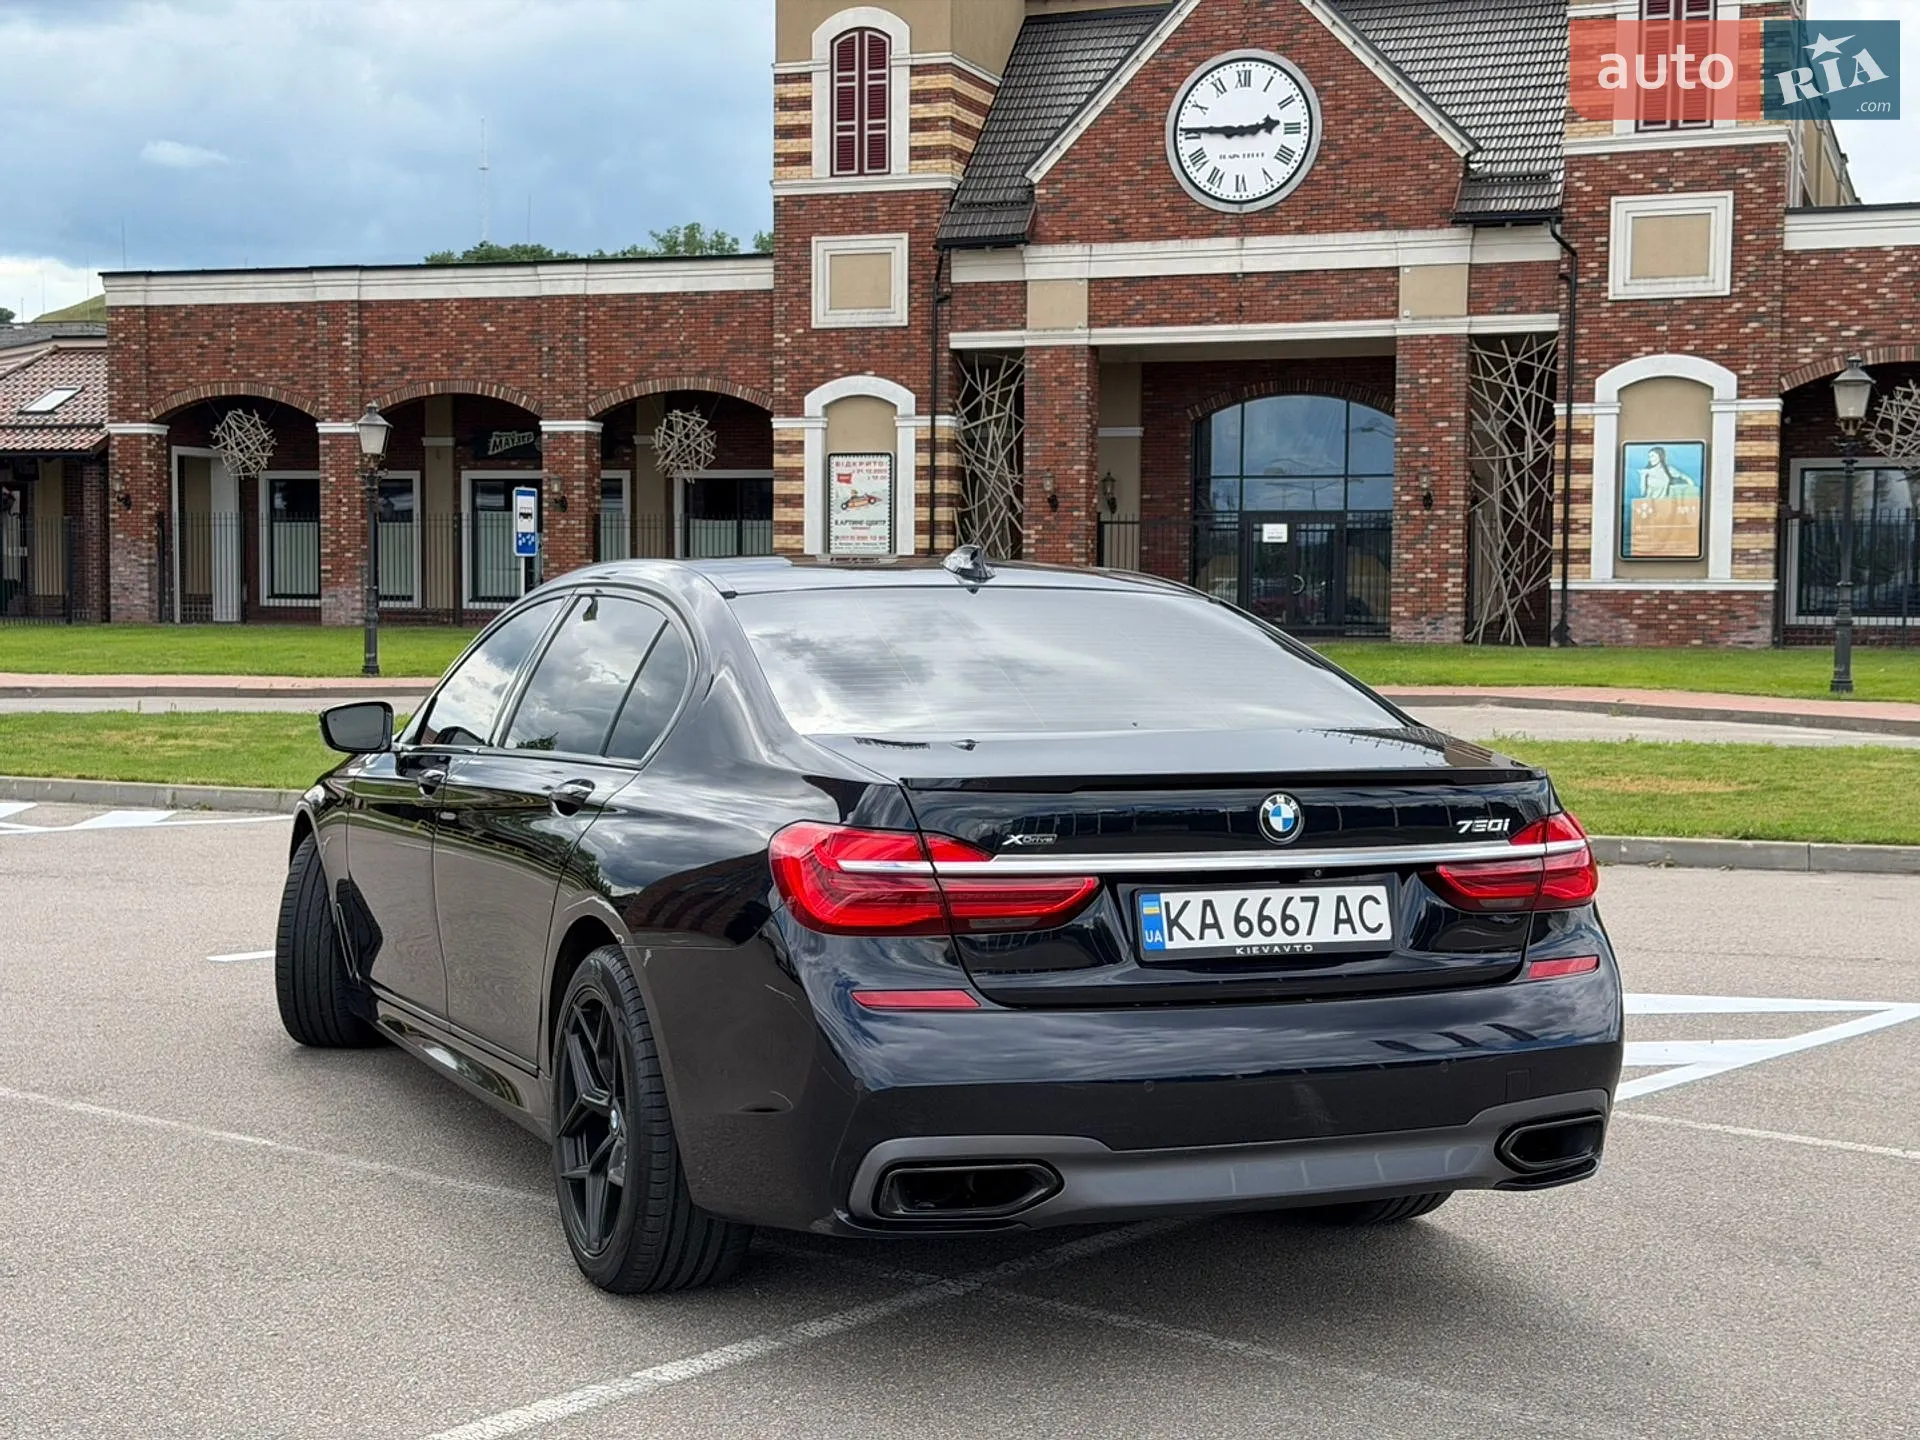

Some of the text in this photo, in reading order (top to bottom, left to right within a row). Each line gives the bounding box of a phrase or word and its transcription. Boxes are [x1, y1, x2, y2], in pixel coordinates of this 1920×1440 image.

[1234, 69, 1252, 88] XII
[1262, 76, 1275, 93] I
[1210, 76, 1228, 98] XI
[1191, 100, 1209, 116] X
[1277, 94, 1296, 110] II
[1283, 121, 1301, 135] III
[1262, 794, 1298, 811] BMW
[1456, 818, 1510, 834] 750i
[1164, 894, 1385, 942] KA 6667 AC
[1145, 930, 1163, 944] UA
[1235, 944, 1314, 955] KIEVAVTO
